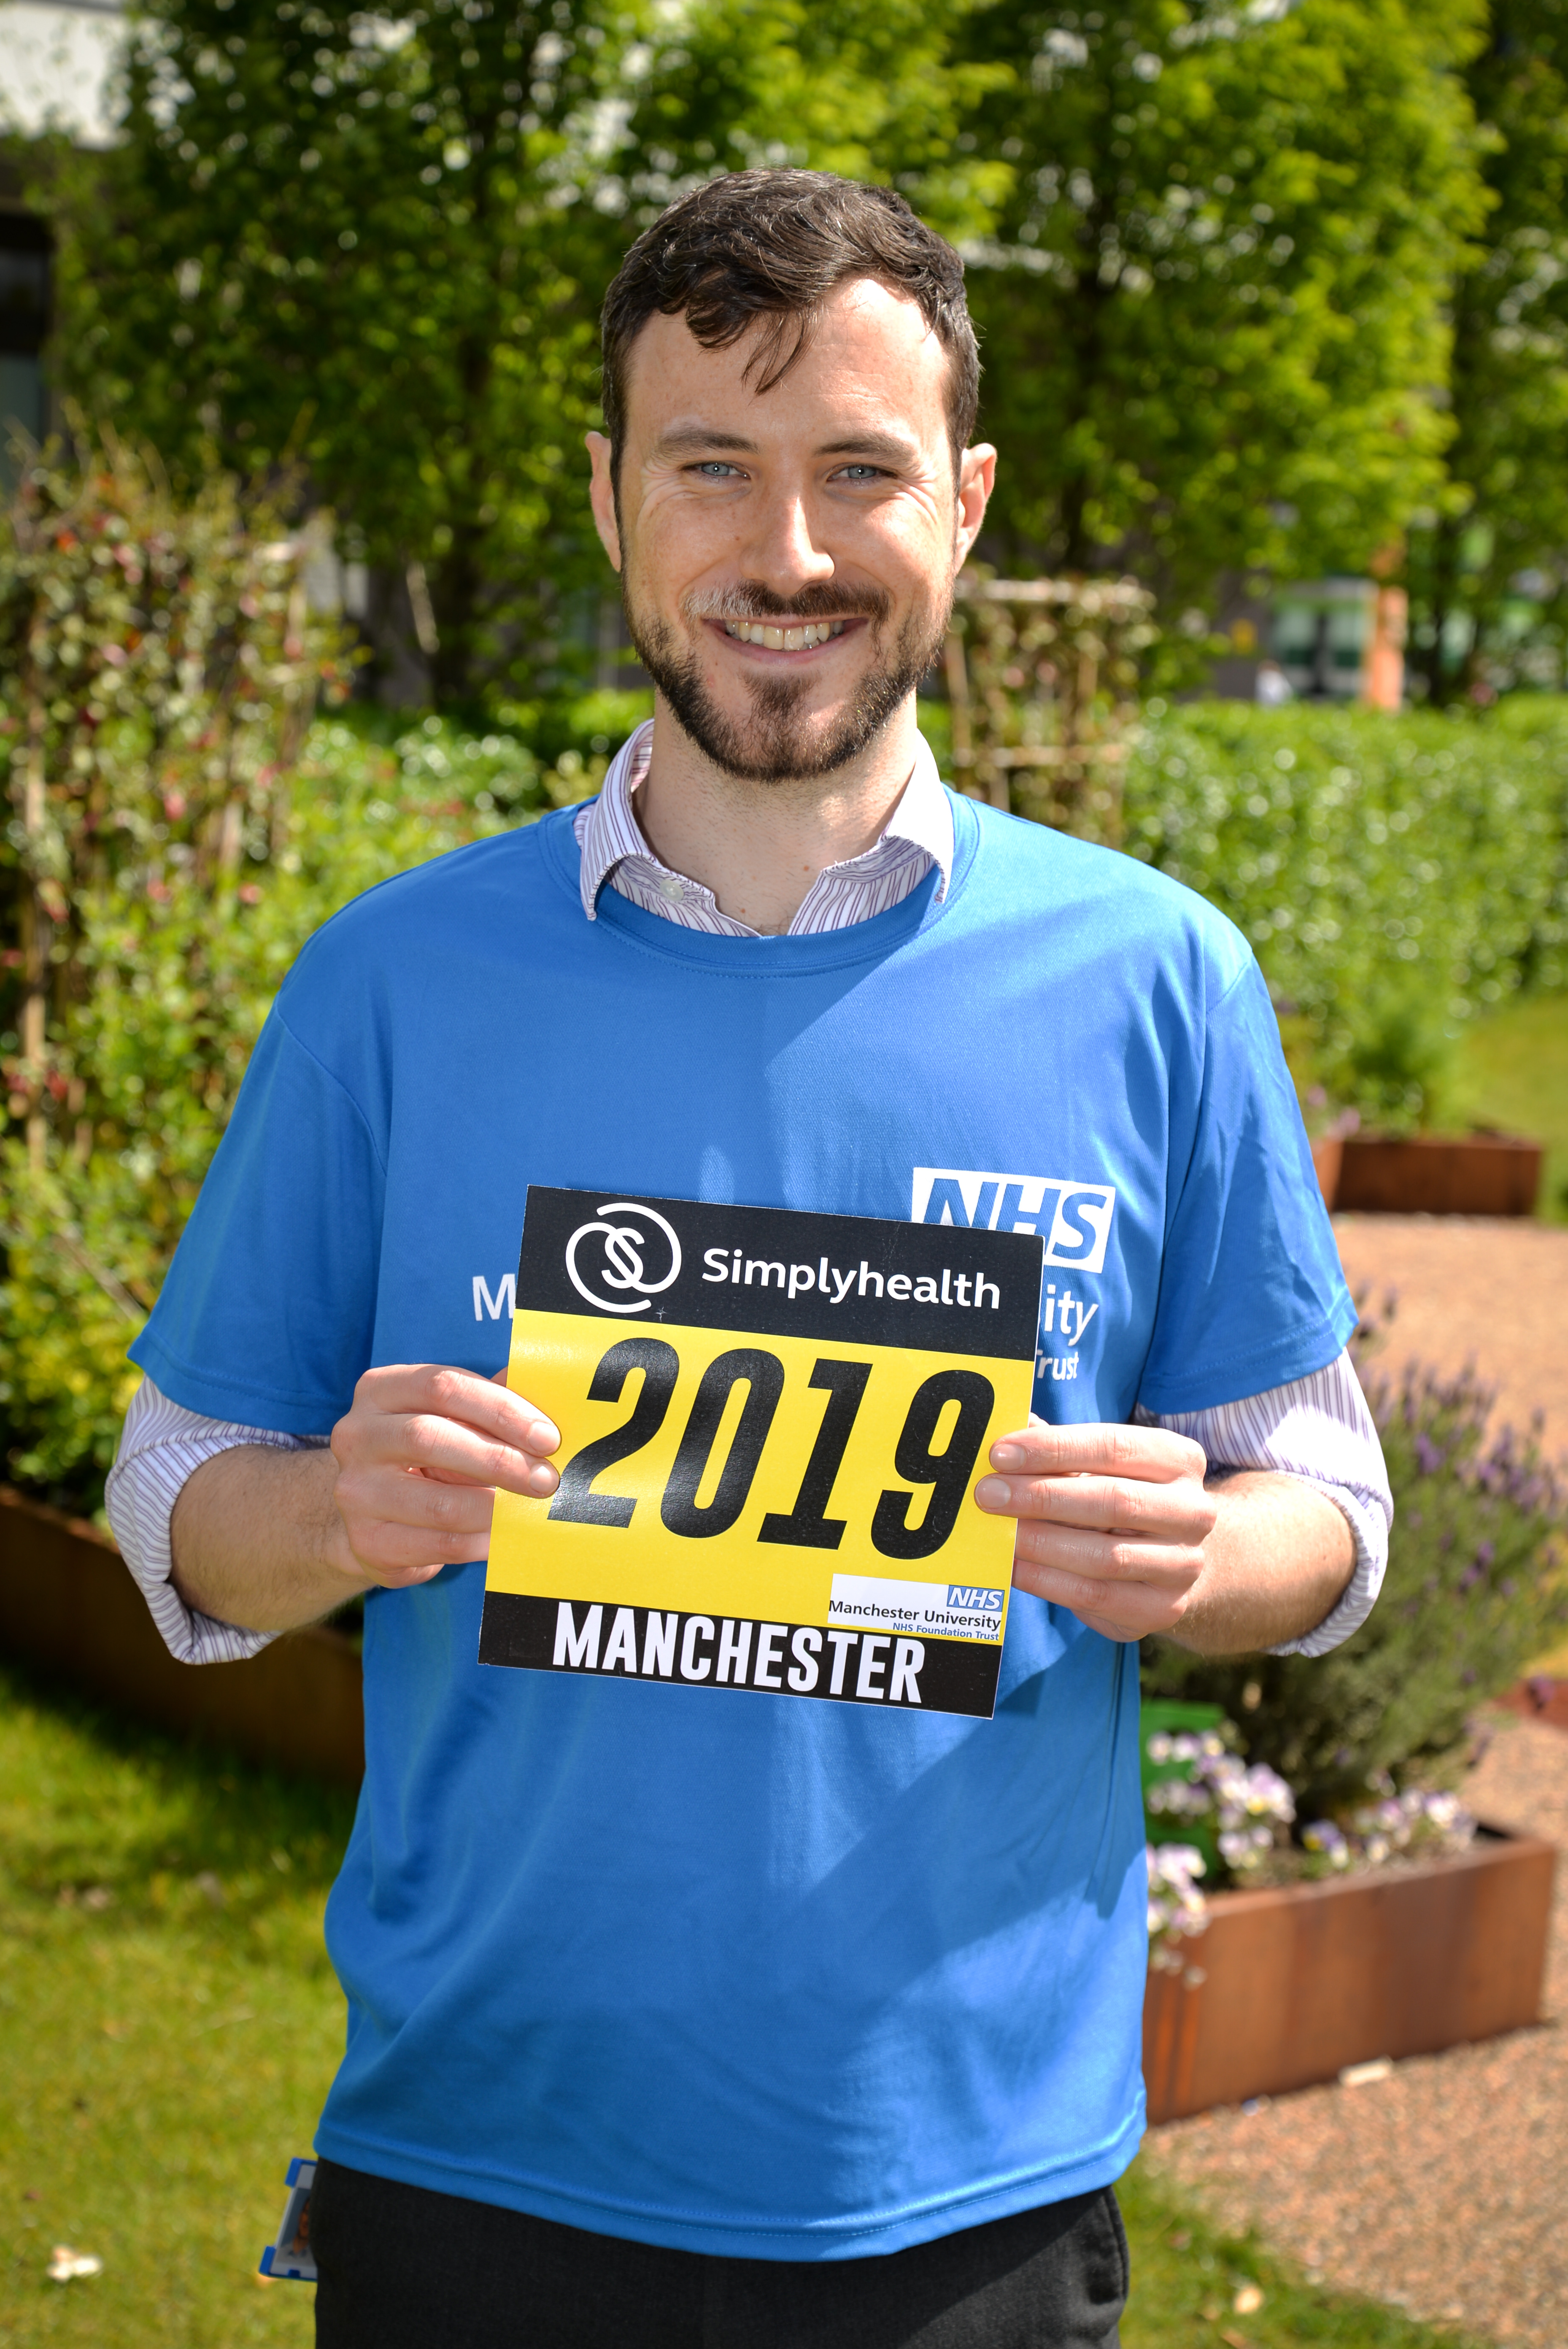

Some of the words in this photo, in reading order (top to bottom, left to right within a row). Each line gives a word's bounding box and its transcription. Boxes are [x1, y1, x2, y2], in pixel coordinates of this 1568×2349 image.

[923, 1178, 1107, 1260] NHS
[702, 1248, 1000, 1310] Simplyhealth
[1036, 1350, 1079, 1380] rust
[547, 1337, 995, 1560] 2019
[829, 1600, 919, 1620] Manchester
[924, 1610, 1001, 1631] University
[949, 1587, 1003, 1610] NHS
[553, 1602, 926, 1703] MANCHESTER
[893, 1622, 913, 1631] NHS
[916, 1625, 972, 1638] Foundation
[976, 1631, 999, 1641] Trust
